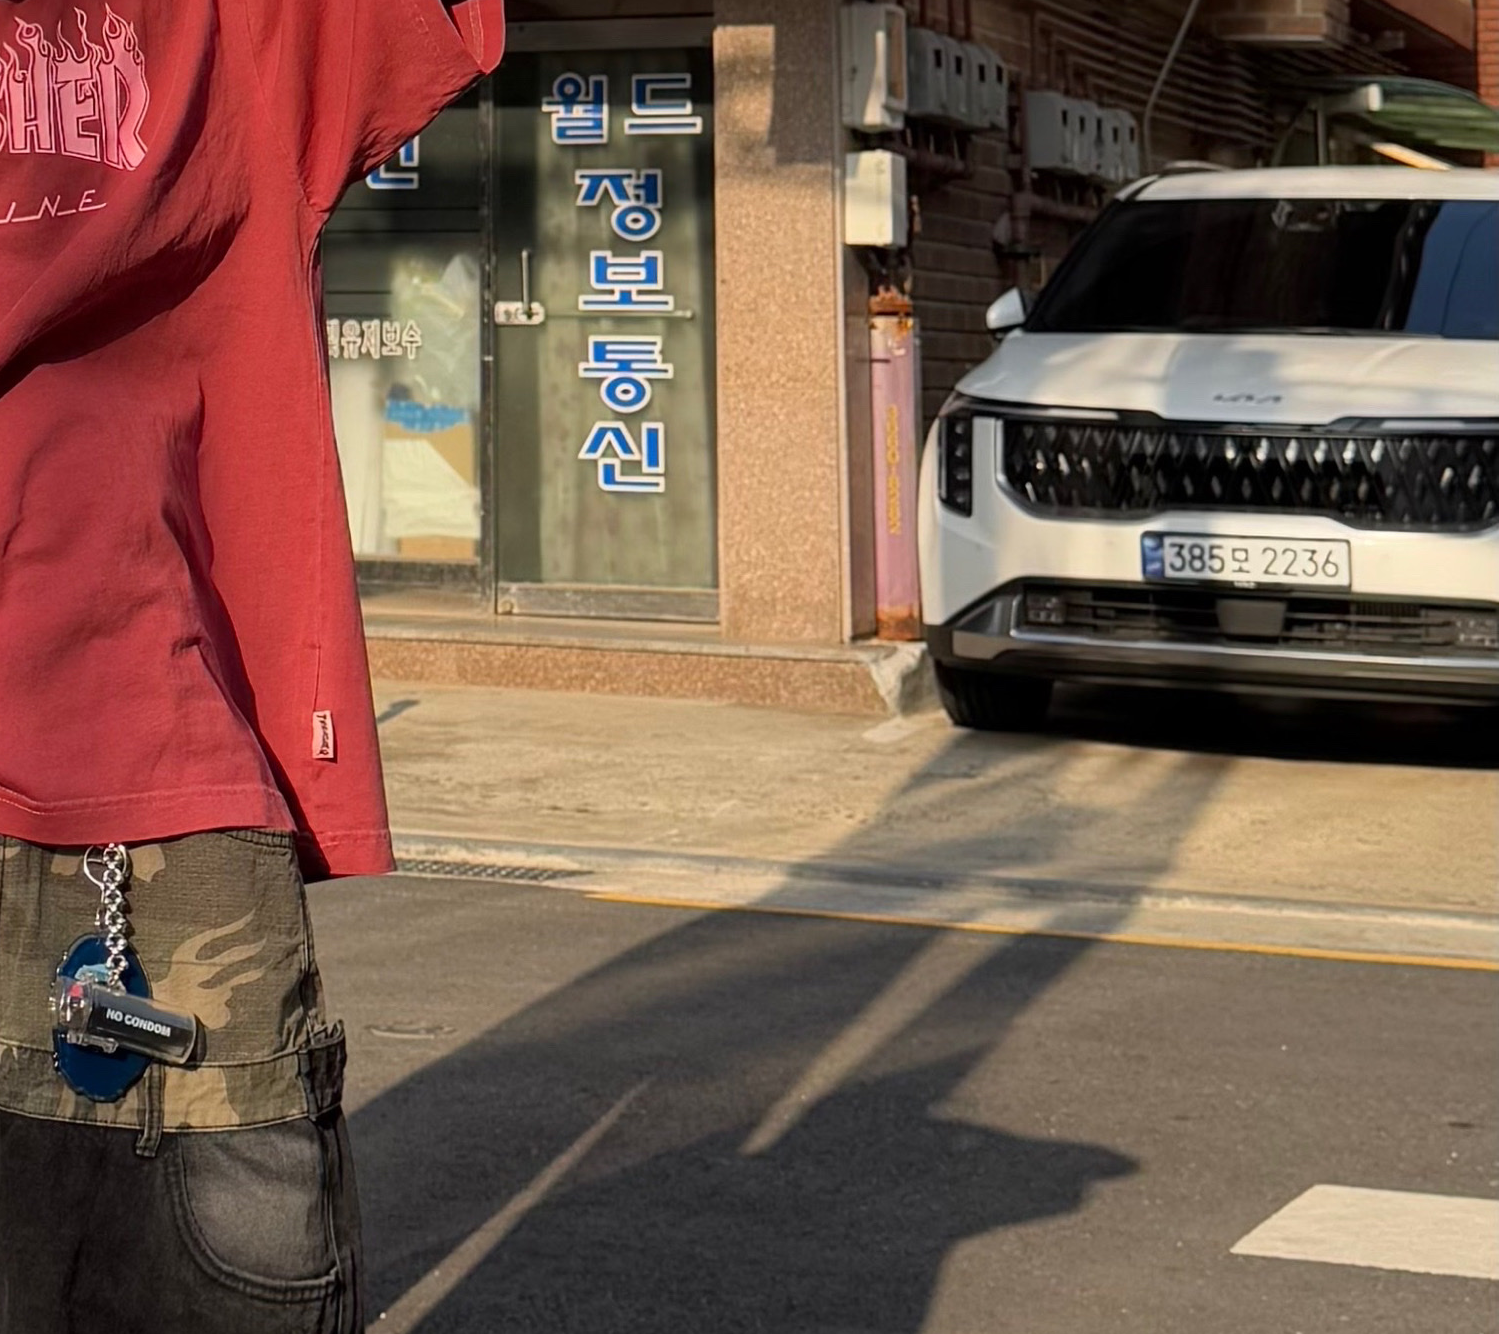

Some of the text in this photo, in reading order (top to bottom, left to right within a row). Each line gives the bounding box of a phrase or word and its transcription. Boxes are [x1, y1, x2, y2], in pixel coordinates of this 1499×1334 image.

[541, 72, 703, 145] 월드
[574, 169, 675, 493] 정보통신
[1168, 542, 1340, 578] 385모 2236
[106, 1007, 171, 1038] NO CONDOM
